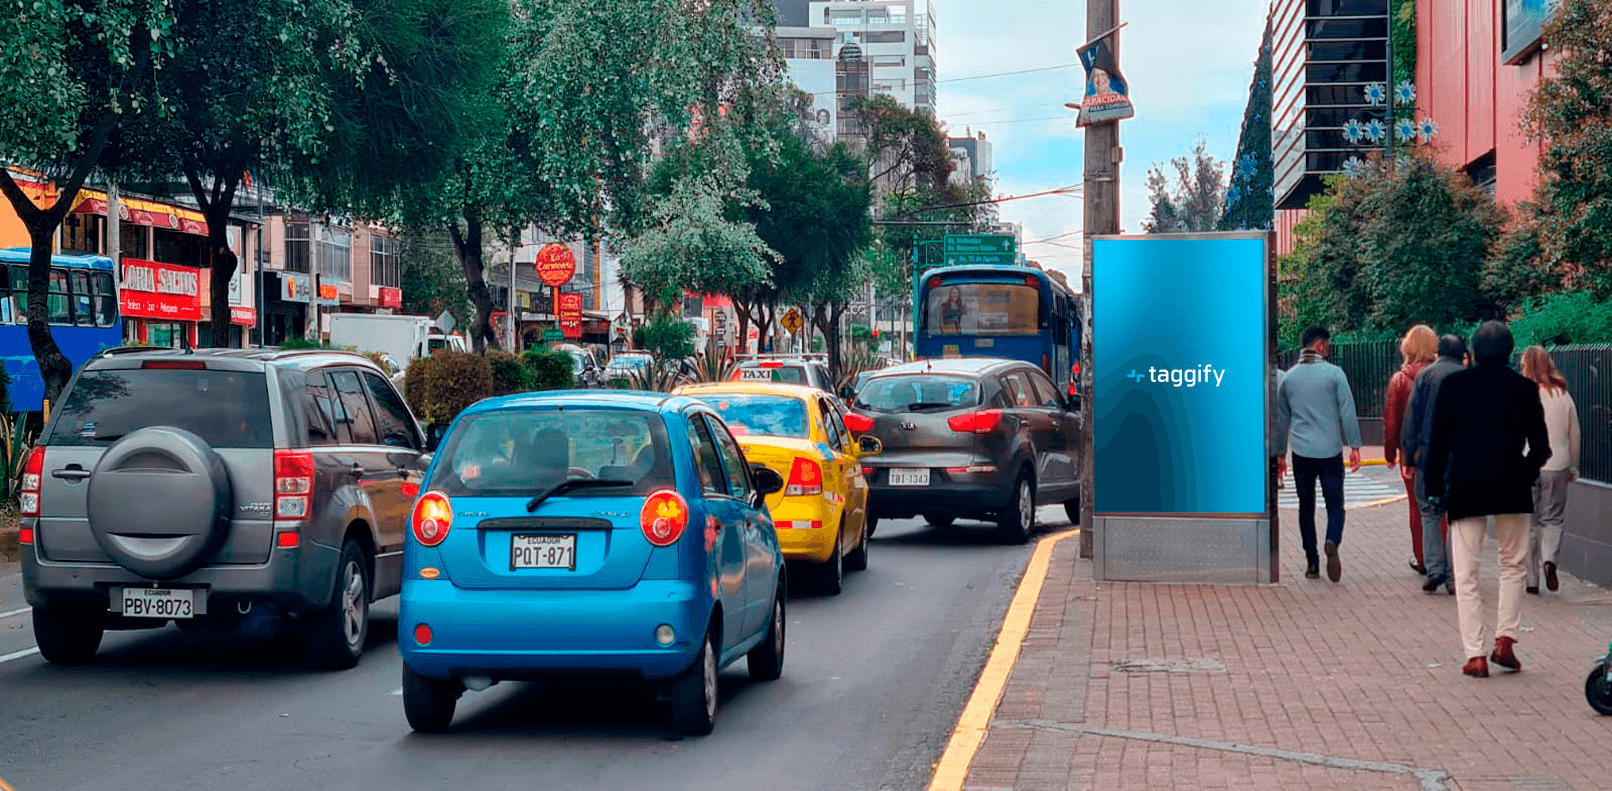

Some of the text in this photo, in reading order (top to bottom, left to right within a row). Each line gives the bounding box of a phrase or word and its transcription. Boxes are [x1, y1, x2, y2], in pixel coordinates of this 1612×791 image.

[119, 264, 198, 296] LORIA SALTOS
[742, 370, 771, 379] TAXI
[1148, 363, 1225, 388] taggify
[513, 546, 573, 566] PQT-871
[124, 598, 192, 616] PBV-8073
